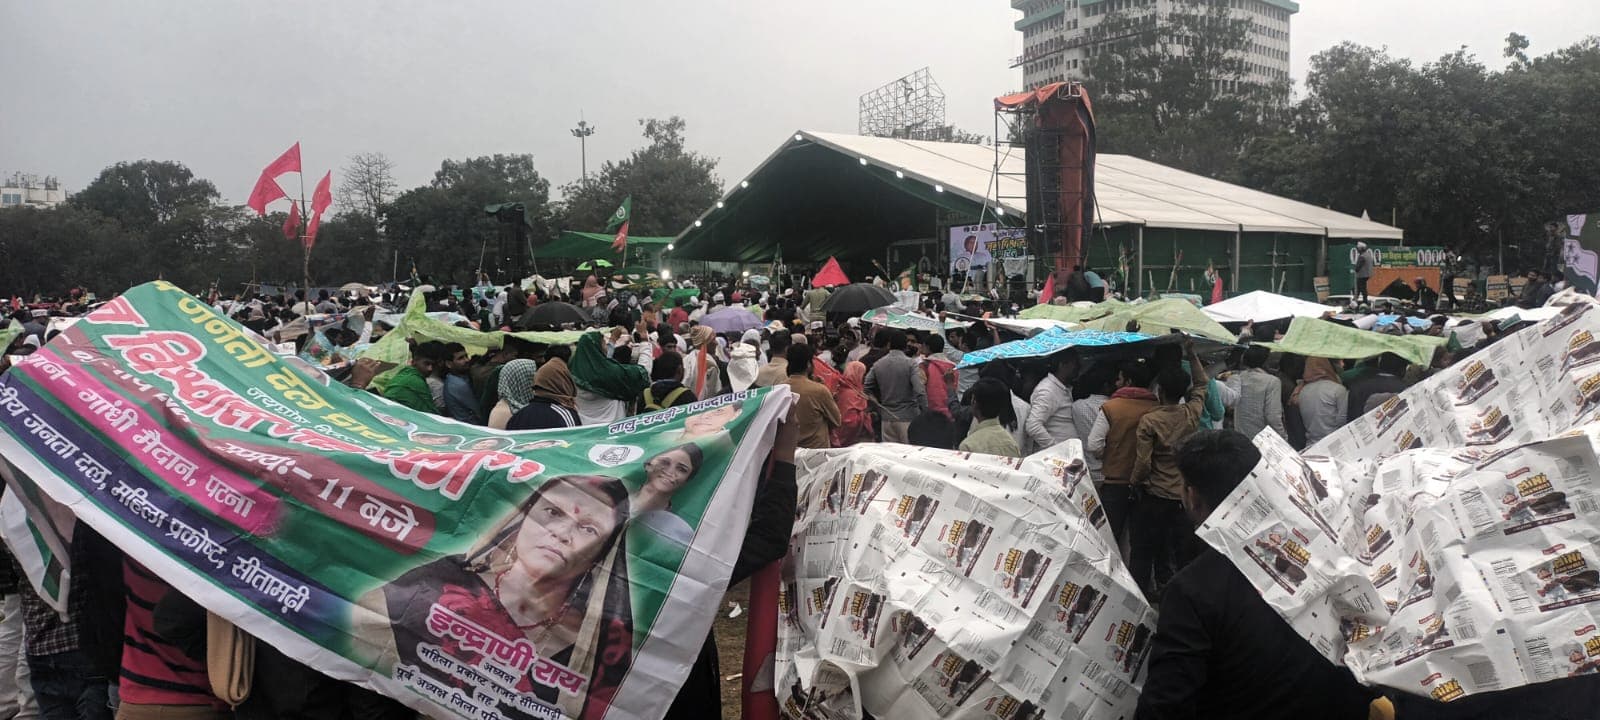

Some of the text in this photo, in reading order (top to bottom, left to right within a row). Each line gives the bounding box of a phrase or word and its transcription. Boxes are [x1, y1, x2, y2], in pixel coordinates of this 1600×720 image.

[179, 297, 277, 368] जनता
[265, 366, 335, 410] दल
[78, 386, 139, 432] गांधी
[132, 428, 200, 487] मैदान,
[204, 474, 257, 519] पटना
[23, 412, 81, 460] जनता
[74, 451, 113, 491] दल,
[111, 478, 169, 529] महिला
[1516, 472, 1549, 493] MINI
[318, 478, 354, 509] 11
[359, 495, 420, 541] बजे
[945, 519, 961, 542] MINI
[1001, 547, 1018, 572] MINI
[1553, 549, 1583, 570] MINI
[1057, 581, 1073, 605] MINI
[428, 605, 588, 694] इन्द्राणी राय
[421, 646, 455, 670] महिला
[490, 680, 518, 702] राजद
[483, 661, 517, 685] अध्यक्ष
[396, 665, 414, 683] पूर्व
[416, 679, 449, 700] अध्यक्ष
[450, 692, 480, 715] जिला
[477, 690, 497, 707] सह
[1431, 678, 1459, 699] MINI
